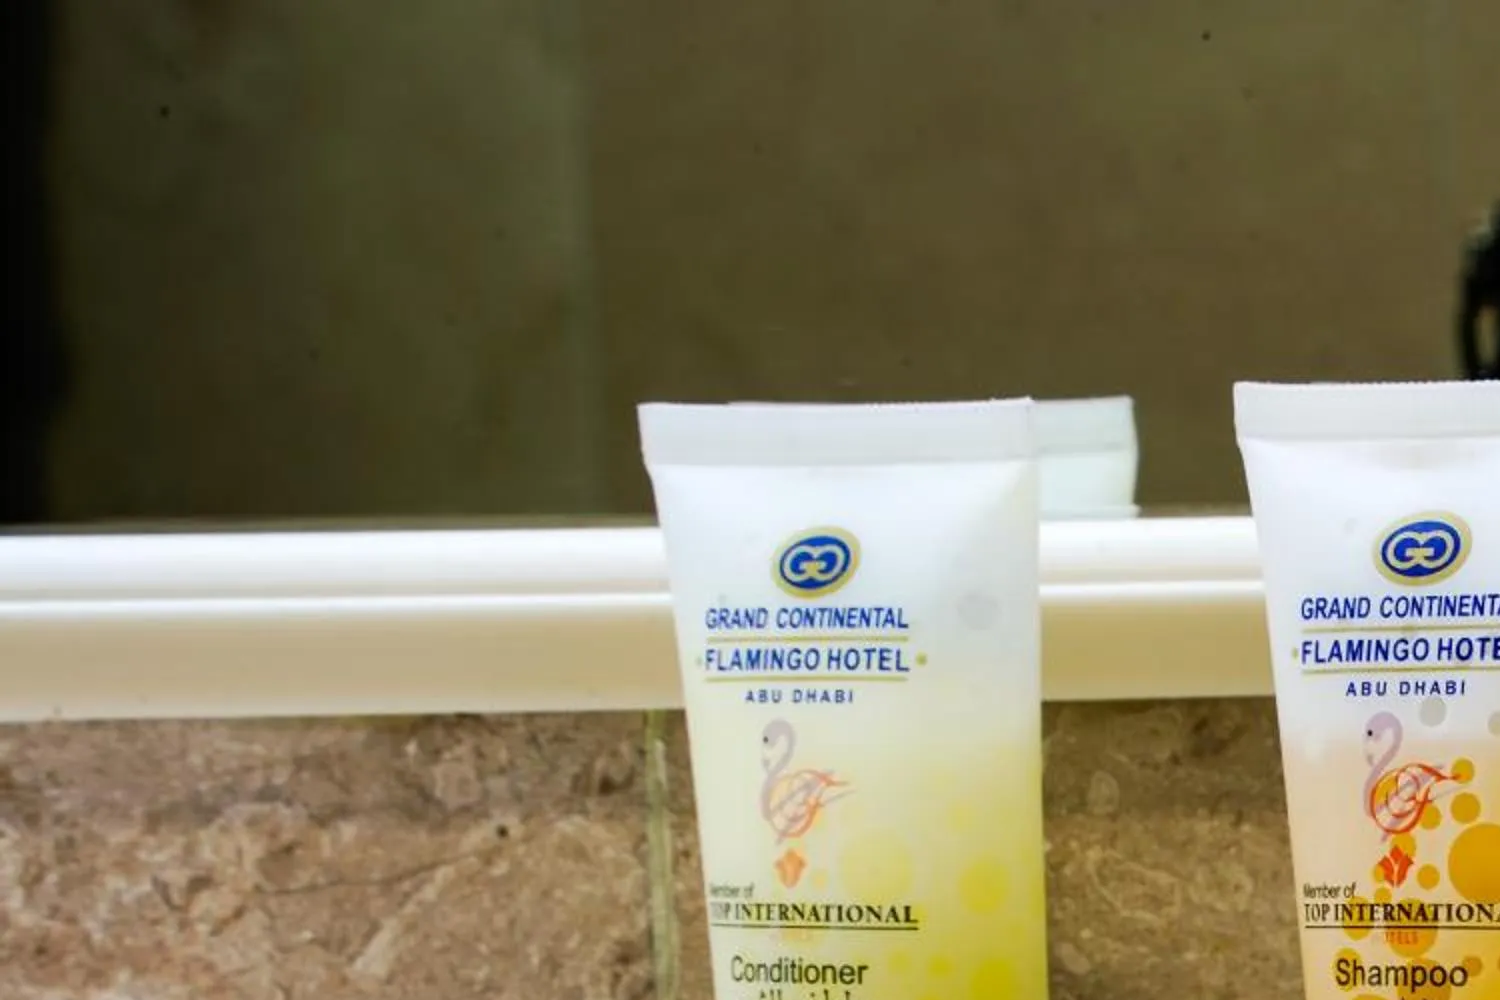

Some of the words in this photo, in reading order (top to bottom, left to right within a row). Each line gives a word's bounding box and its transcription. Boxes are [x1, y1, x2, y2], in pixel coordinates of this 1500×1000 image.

[705, 607, 768, 629] GRAND
[776, 607, 909, 629] CONTINENTAL
[1301, 596, 1371, 620] GRAND
[705, 648, 820, 672] FLAMINGO
[827, 648, 910, 672] HOTEL
[1301, 637, 1430, 664] FLAMINGO
[745, 689, 782, 704] ABU
[793, 689, 854, 704] DHABI
[1346, 681, 1388, 697] ABU
[1399, 679, 1466, 696] DHABI
[1303, 883, 1340, 899] Member
[1343, 882, 1357, 899] of
[734, 903, 918, 924] INTERNATIONAL
[1304, 903, 1330, 922] TOP
[731, 955, 869, 985] Conditioner
[1336, 958, 1468, 993] Shampoo
